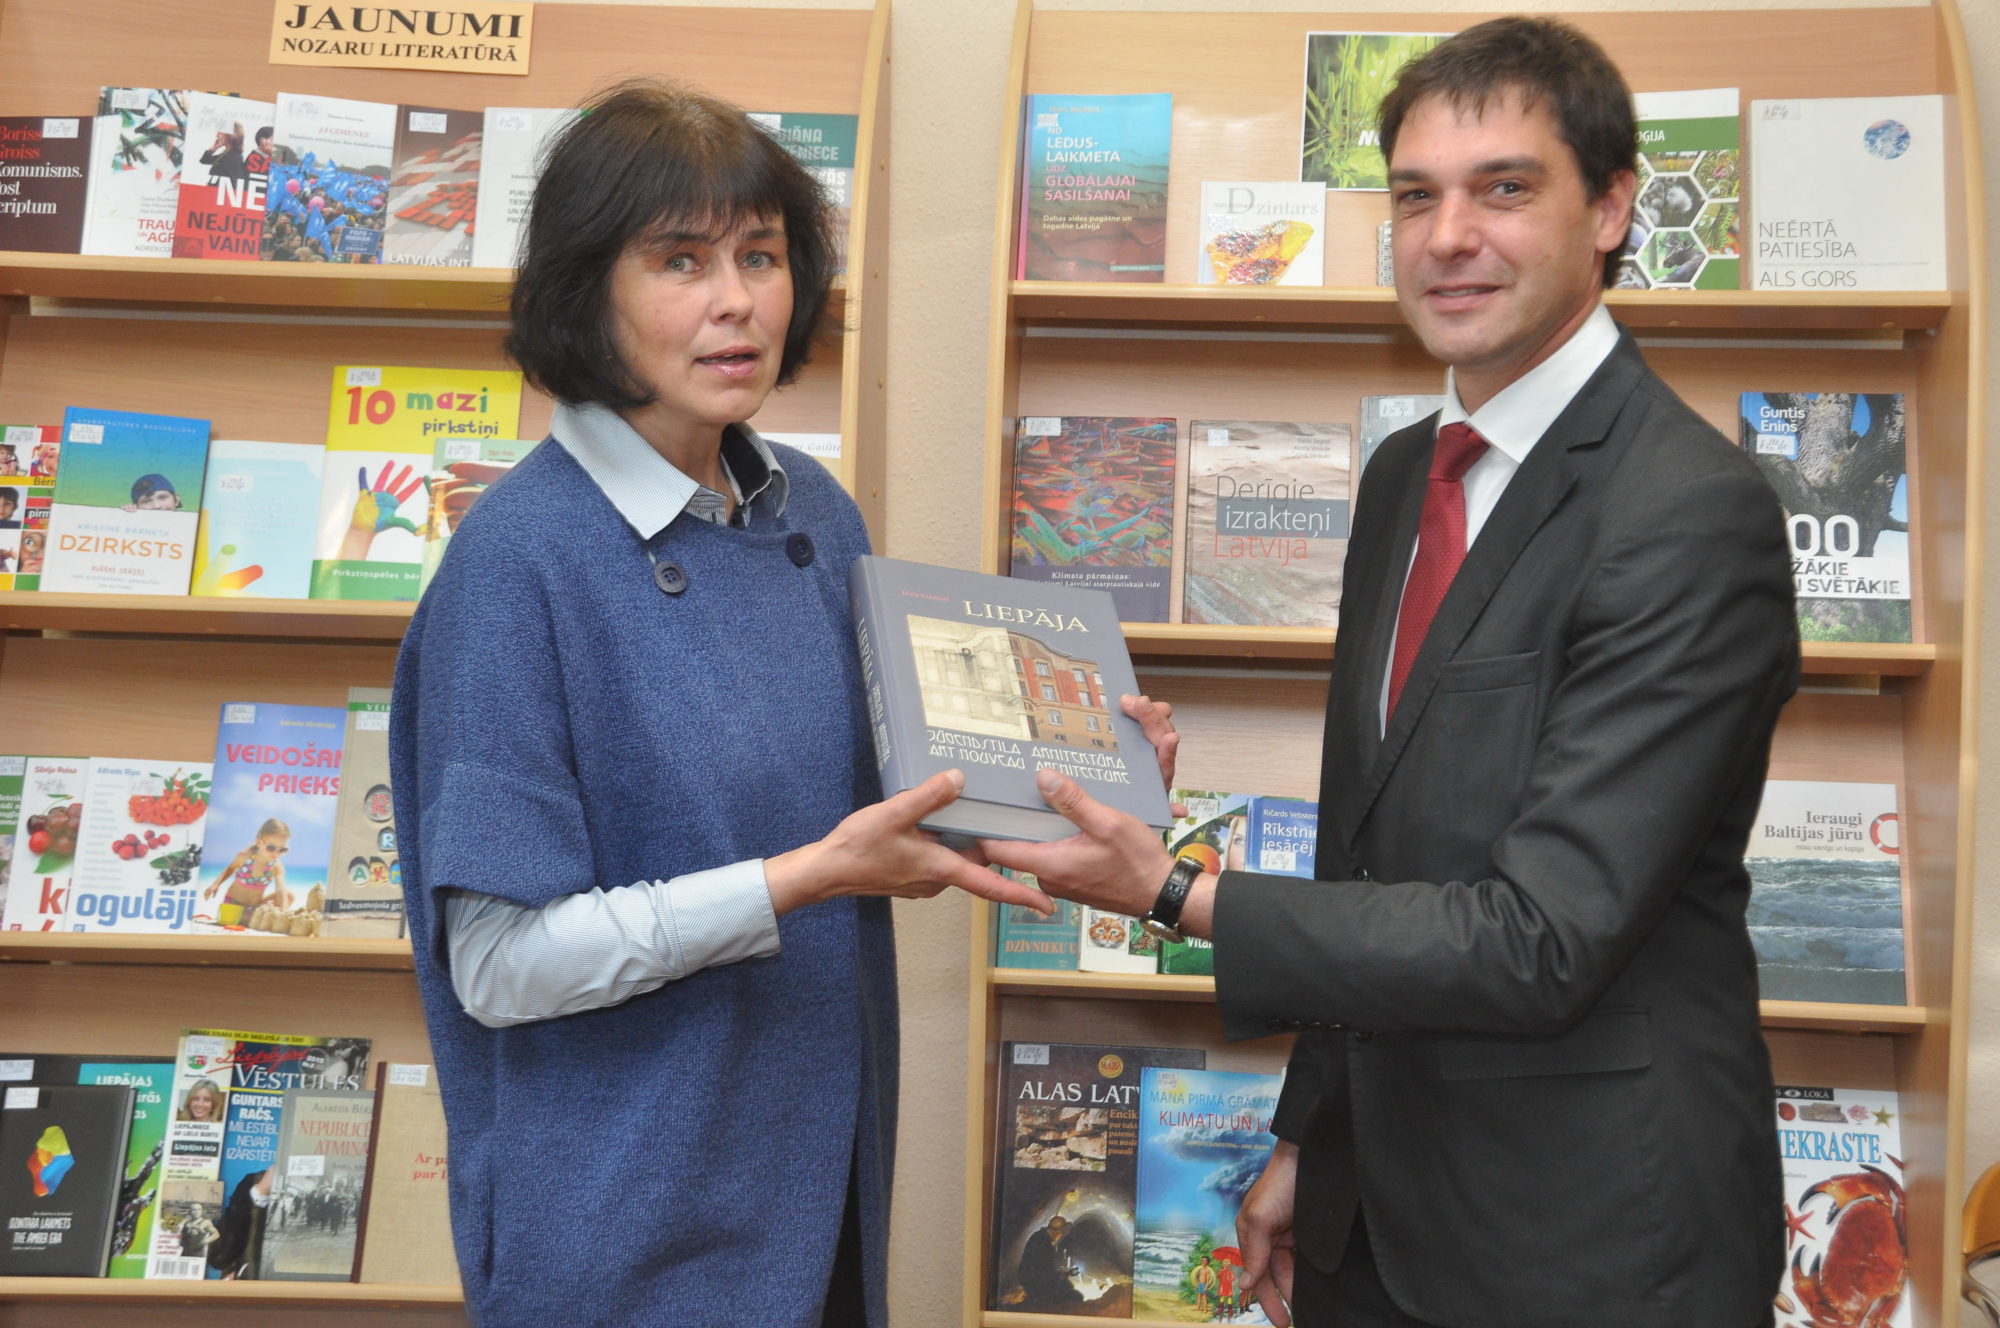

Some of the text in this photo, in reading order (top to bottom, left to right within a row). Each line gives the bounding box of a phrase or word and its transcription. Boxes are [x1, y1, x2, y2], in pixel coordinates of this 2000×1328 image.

[285, 4, 525, 38] JAUNUMI
[282, 38, 518, 62] NOZARU LITERATŪRĀ
[1047, 136, 1099, 149] LEDUS-
[1046, 151, 1121, 163] LAIKMETA
[1045, 173, 1136, 187] GLOBĀLAJAI
[1045, 187, 1131, 201] SASILŠANAI
[1759, 219, 1837, 238] NEĒRTĀ
[1759, 239, 1857, 258] PATIESĪBA
[1759, 271, 1857, 287] ALS GORS
[346, 386, 488, 425] 10 mazi
[1760, 405, 1806, 419] Guntis
[422, 418, 499, 438] pirkstiņi
[1761, 418, 1798, 436] Eniņš
[1217, 475, 1315, 509] Derīgie
[1225, 504, 1331, 537] izrakteņi
[59, 533, 183, 560] DZIRKSTS
[1214, 532, 1309, 567] Latvijā
[1807, 577, 1900, 595] SVĒTĀKIE
[962, 600, 1090, 633] LIEPĀJA
[929, 744, 1026, 770] ART NOUVEAU
[1263, 808, 1288, 818] Ričards
[1806, 811, 1862, 828] Ieraugi
[1764, 824, 1864, 842] Baltijas jūru
[235, 1063, 360, 1091] VĒSTULES
[1019, 1081, 1081, 1102] ALAS
[1160, 1111, 1224, 1129] KLIMATU
[1231, 1115, 1251, 1131] UN
[415, 1152, 431, 1163] Ar
[413, 1170, 437, 1181] par
